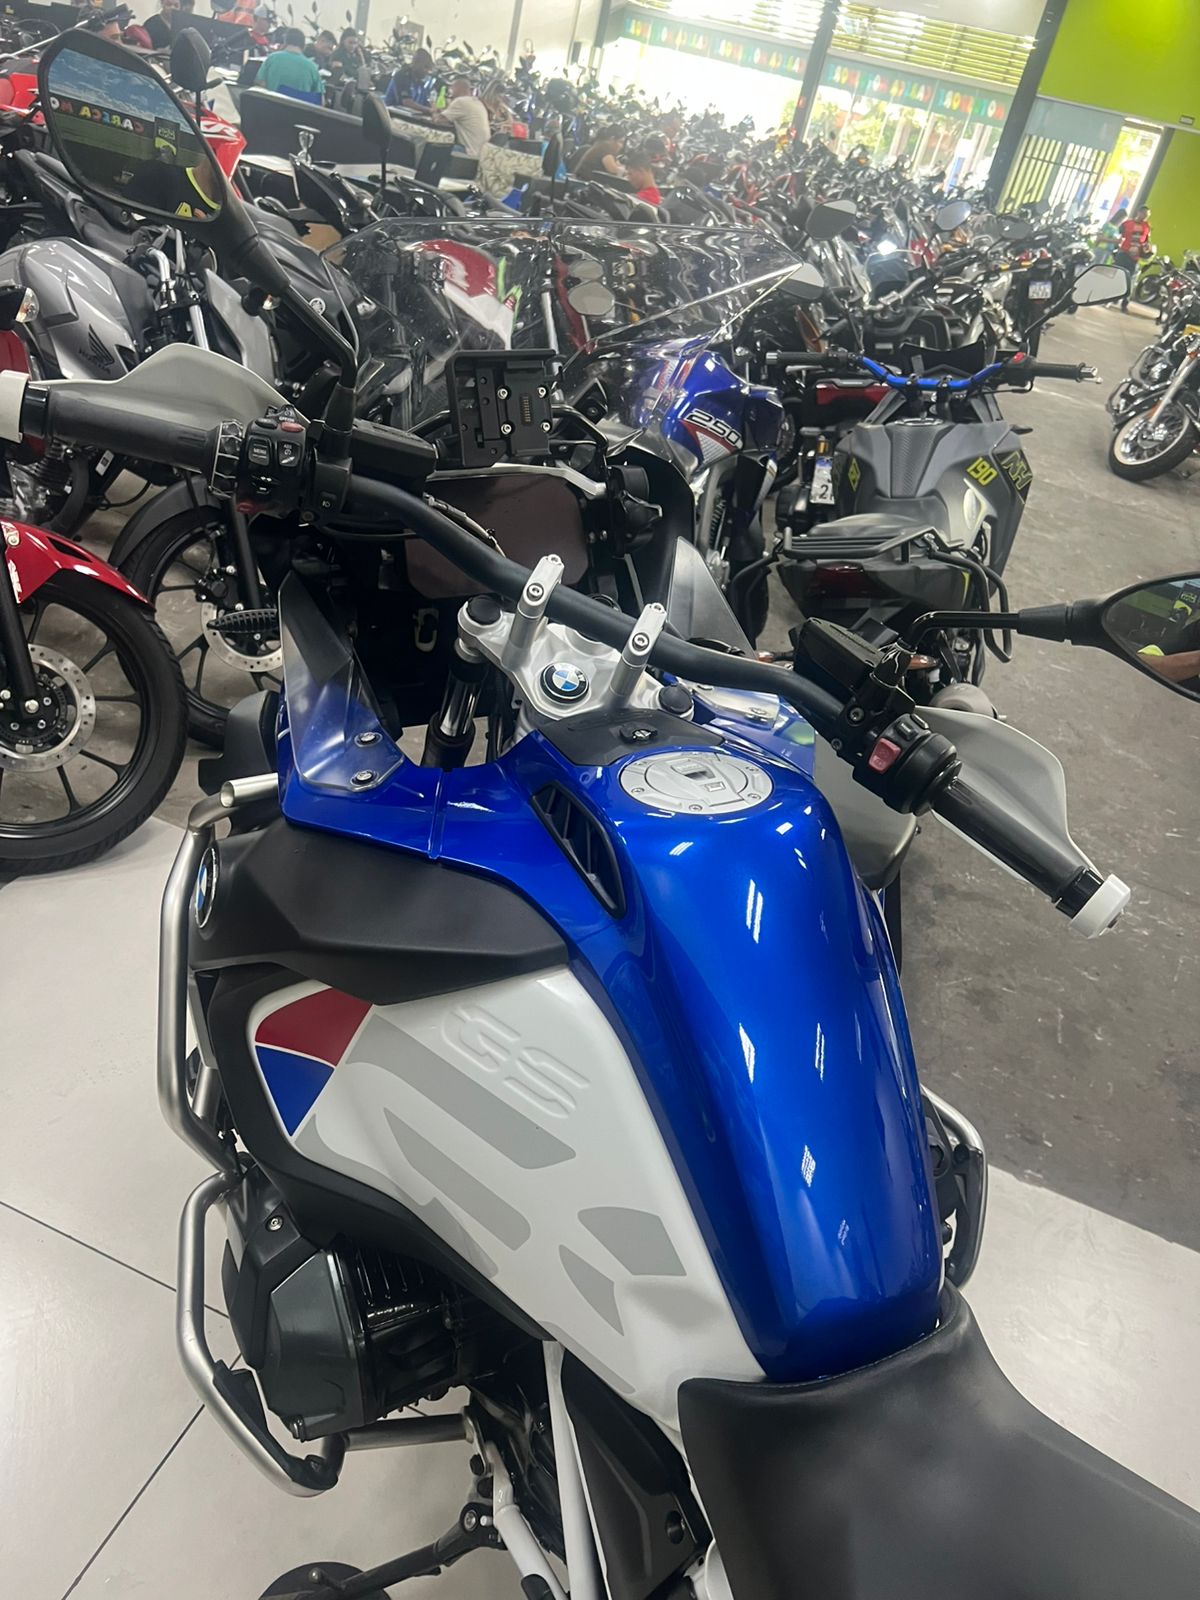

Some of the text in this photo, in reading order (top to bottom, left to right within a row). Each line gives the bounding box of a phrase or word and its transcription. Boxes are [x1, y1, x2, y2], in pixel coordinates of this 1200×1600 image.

[681, 408, 742, 447] 250
[966, 457, 998, 486] 190
[441, 1004, 591, 1119] GS
